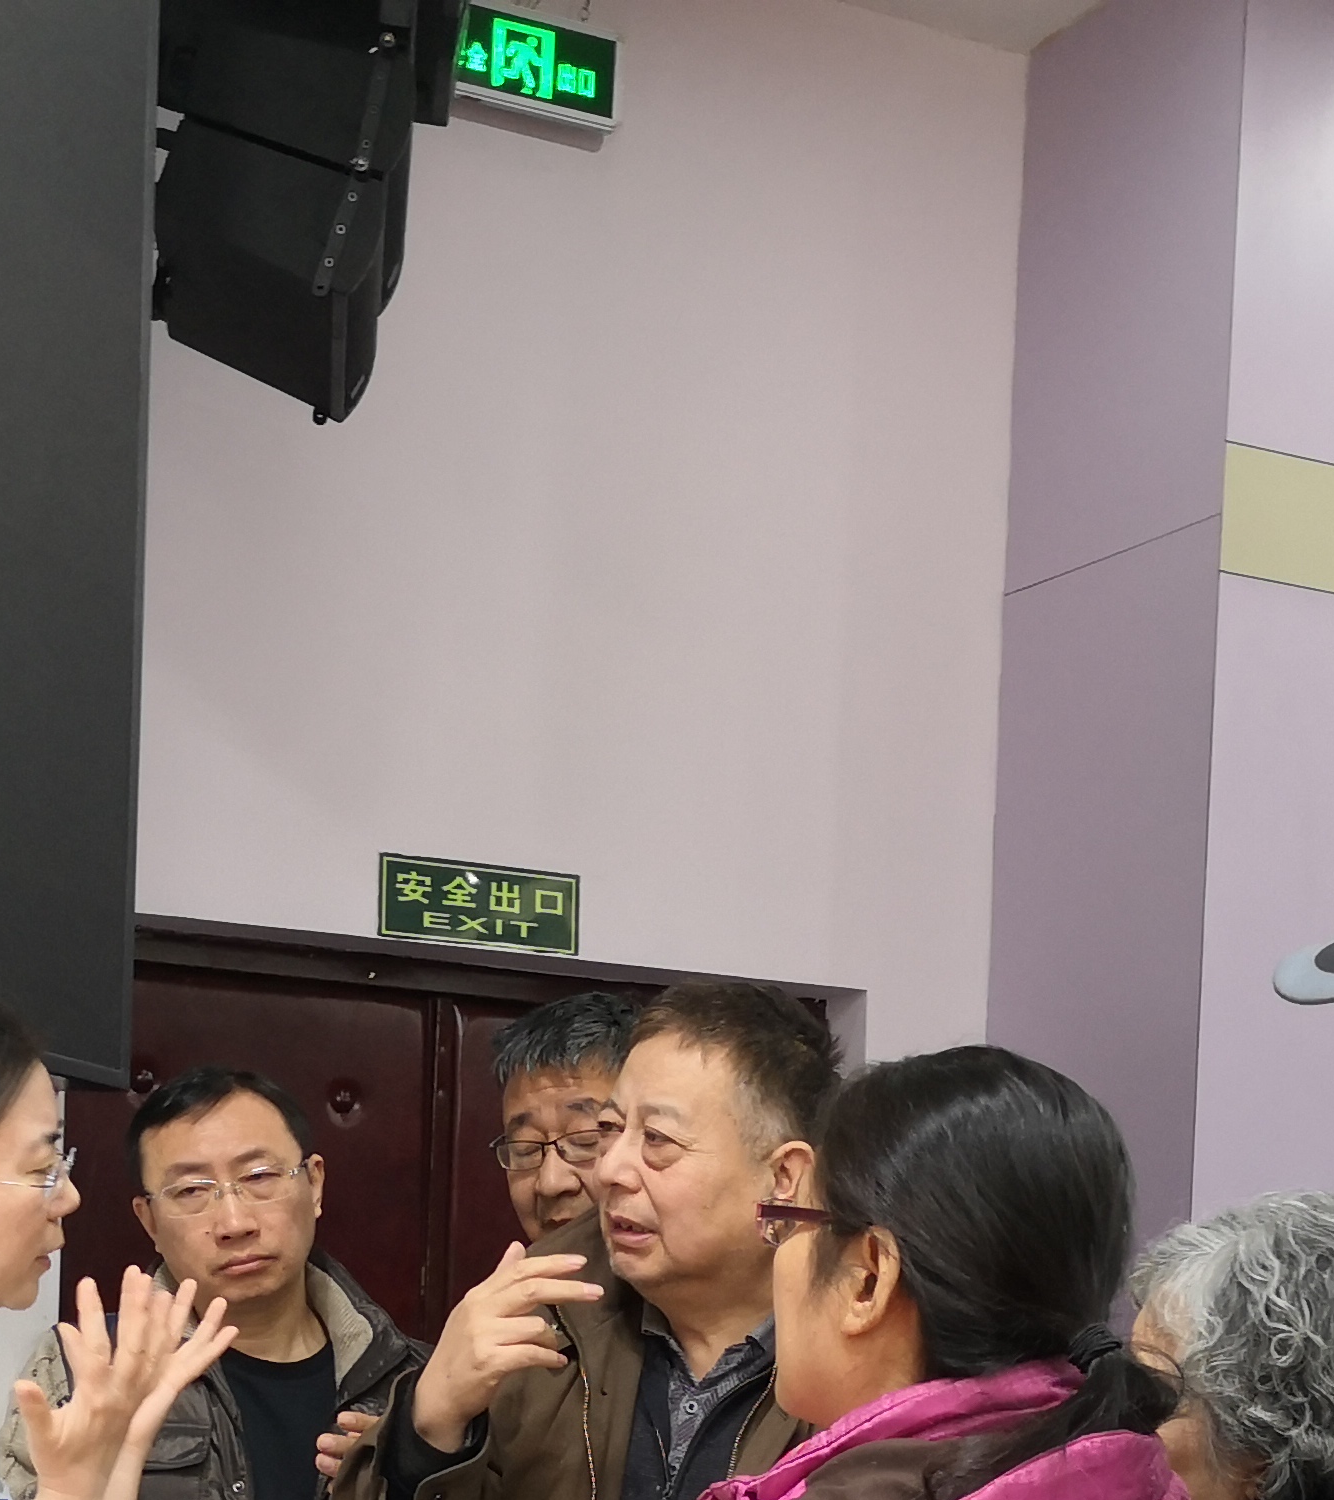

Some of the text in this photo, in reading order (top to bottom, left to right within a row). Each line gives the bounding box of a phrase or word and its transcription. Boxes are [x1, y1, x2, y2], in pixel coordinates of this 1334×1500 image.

[395, 871, 564, 916] 安全出口
[423, 911, 539, 938] EXIT
